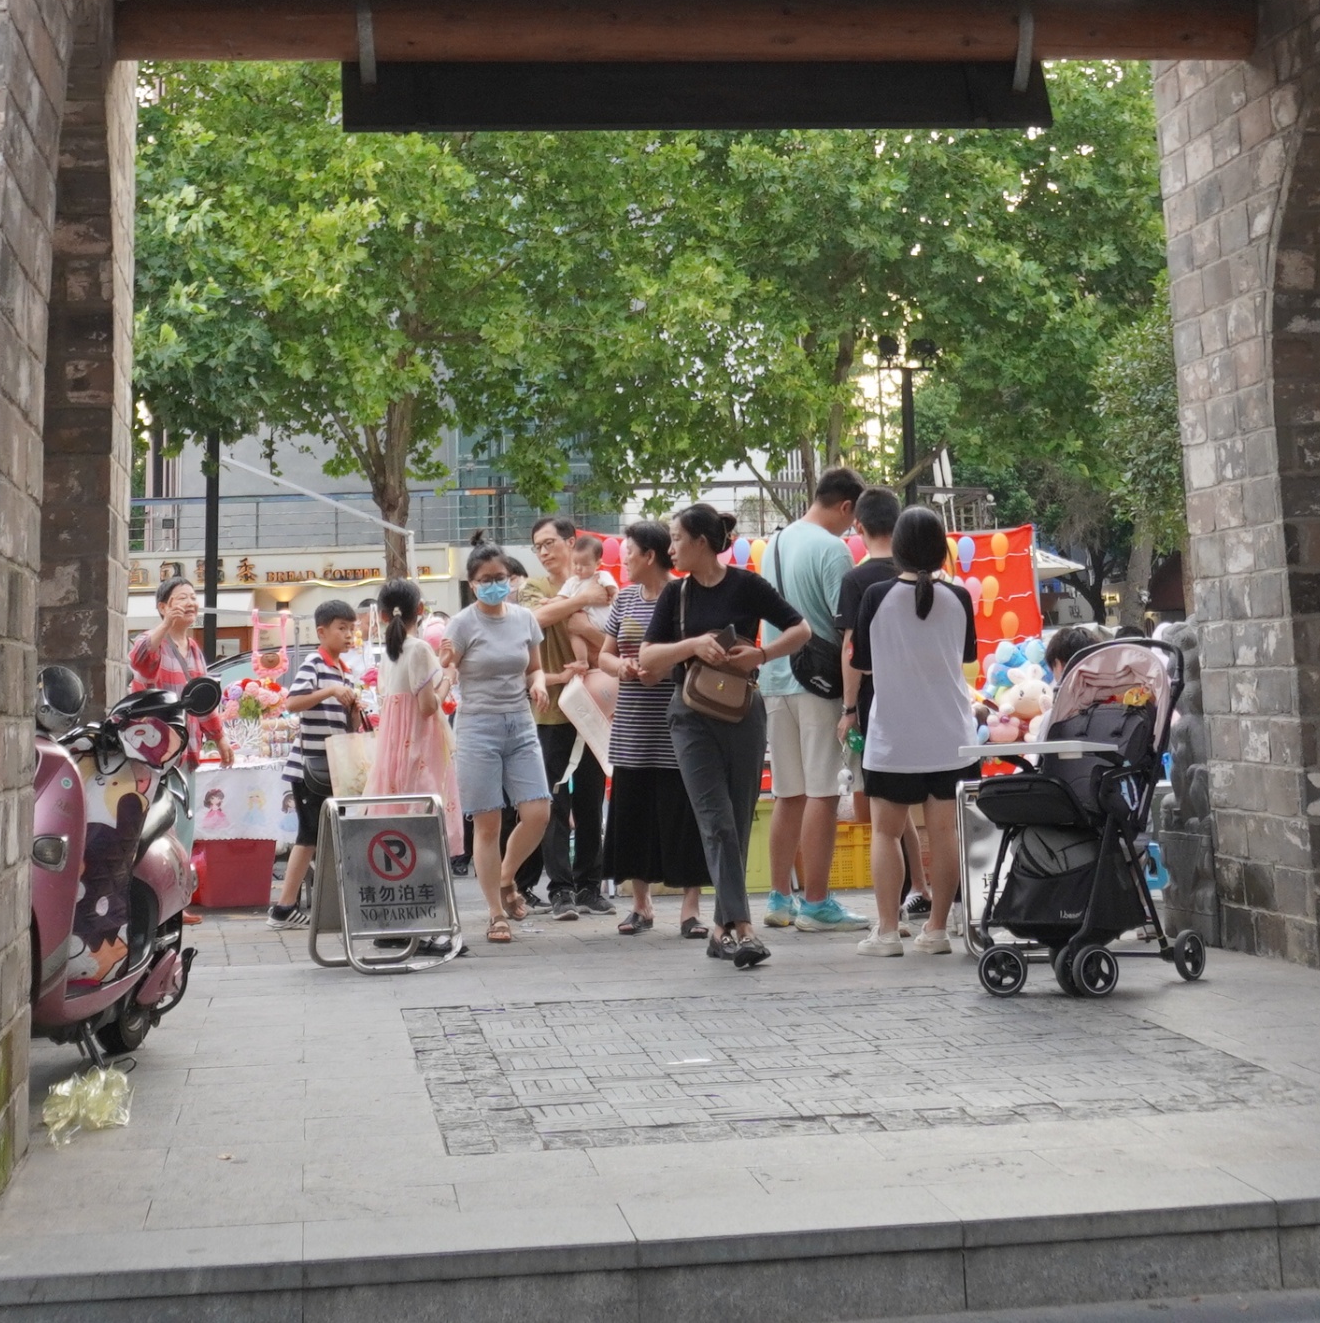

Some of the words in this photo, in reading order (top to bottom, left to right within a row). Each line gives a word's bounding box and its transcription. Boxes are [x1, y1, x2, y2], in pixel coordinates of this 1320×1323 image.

[266, 570, 316, 583] BREAD
[323, 567, 381, 581] COFFEE
[358, 883, 435, 903] 请勿泊车
[360, 908, 378, 922] NO
[383, 905, 437, 923] PARKING
